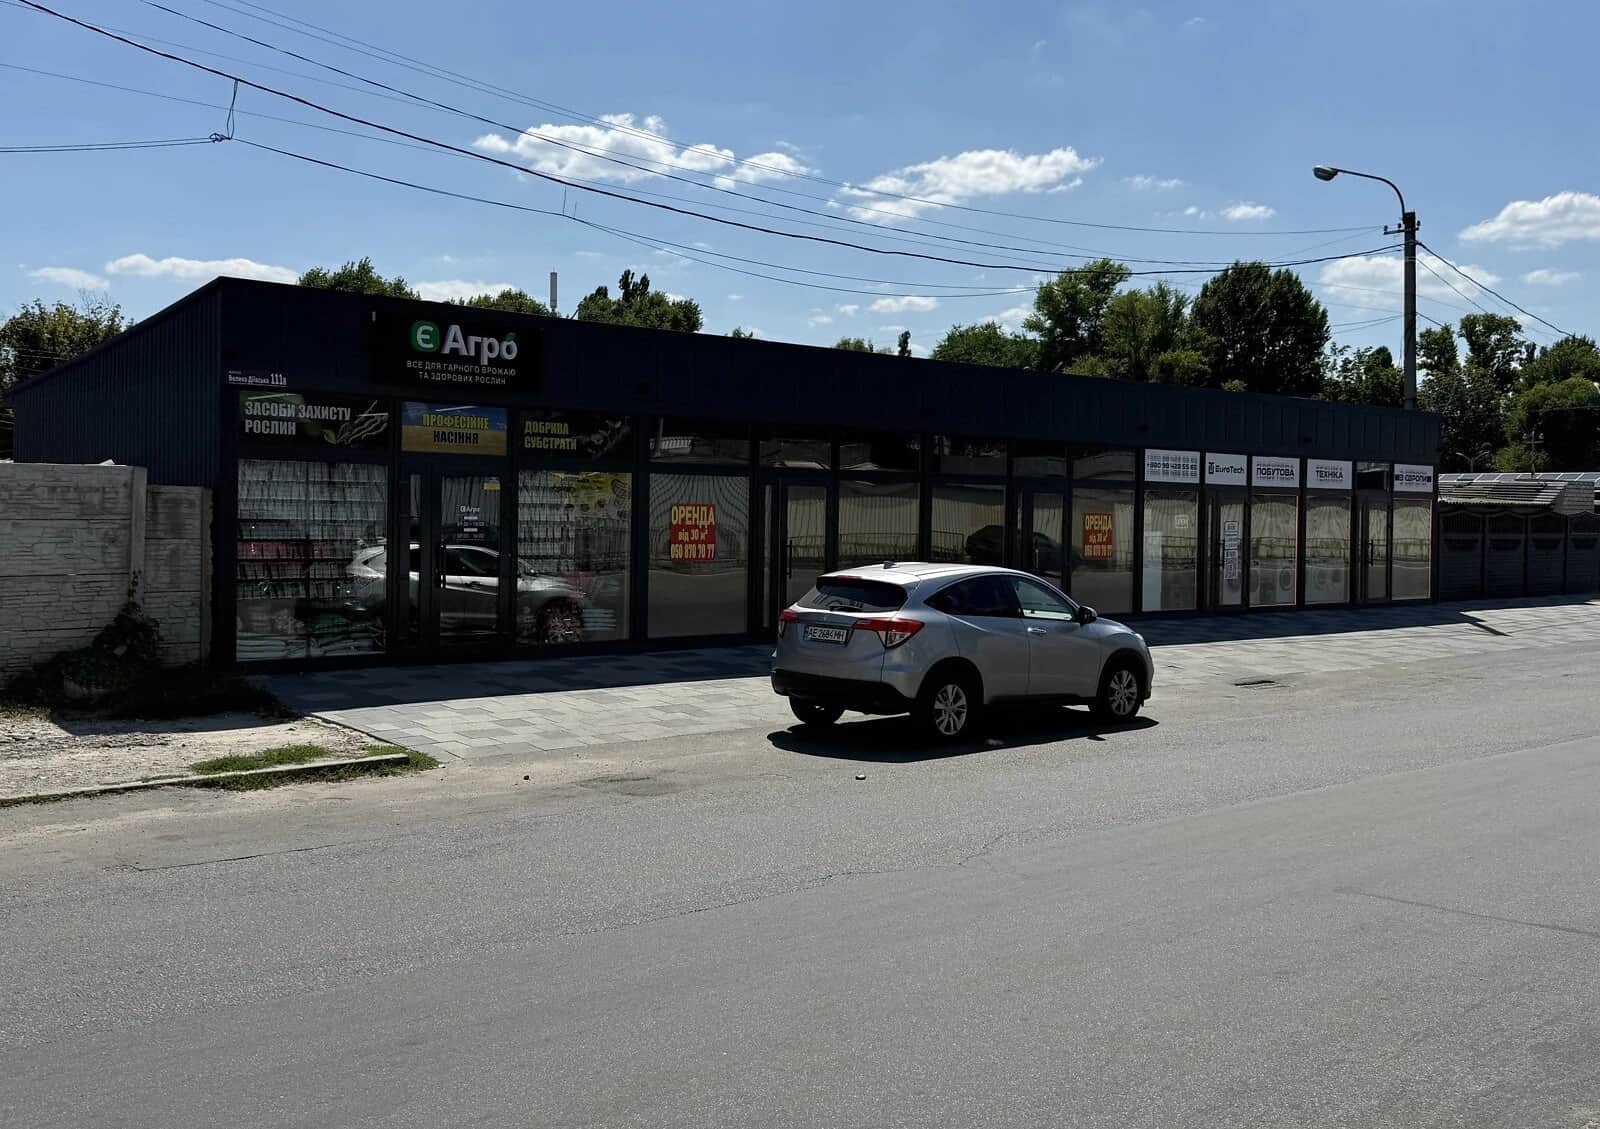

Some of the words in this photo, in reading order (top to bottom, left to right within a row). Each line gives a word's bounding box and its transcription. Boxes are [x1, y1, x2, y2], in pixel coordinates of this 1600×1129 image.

[440, 324, 518, 366] Агро
[406, 360, 423, 369] ВСЕ
[424, 361, 442, 371] ДЛЯ
[443, 363, 480, 374] ГАРНОГО
[481, 366, 516, 377] ВРОЖАЮ
[418, 371, 429, 379] ТА
[431, 373, 473, 382] ЗДОРОВИХ
[475, 375, 506, 385] РОСЛИН
[244, 401, 295, 418] ЗАСОБИ
[297, 404, 351, 421] ЗАХИСТУ
[244, 419, 296, 436] РОСЛИН
[422, 413, 489, 430] ПРОФЕСІЙНЕ
[524, 420, 569, 435] ДОБРИВА
[433, 430, 479, 445] НАСІННЯ
[524, 435, 577, 451] СУБСТРАТИ
[1214, 464, 1245, 474] EuroTech
[1256, 467, 1295, 478] ПОБУТОВА
[1315, 470, 1344, 479] ТЕХНІКА
[671, 505, 715, 528] ОРЕНДА
[1085, 514, 1112, 531] ОРЕНДА
[678, 528, 690, 542] від
